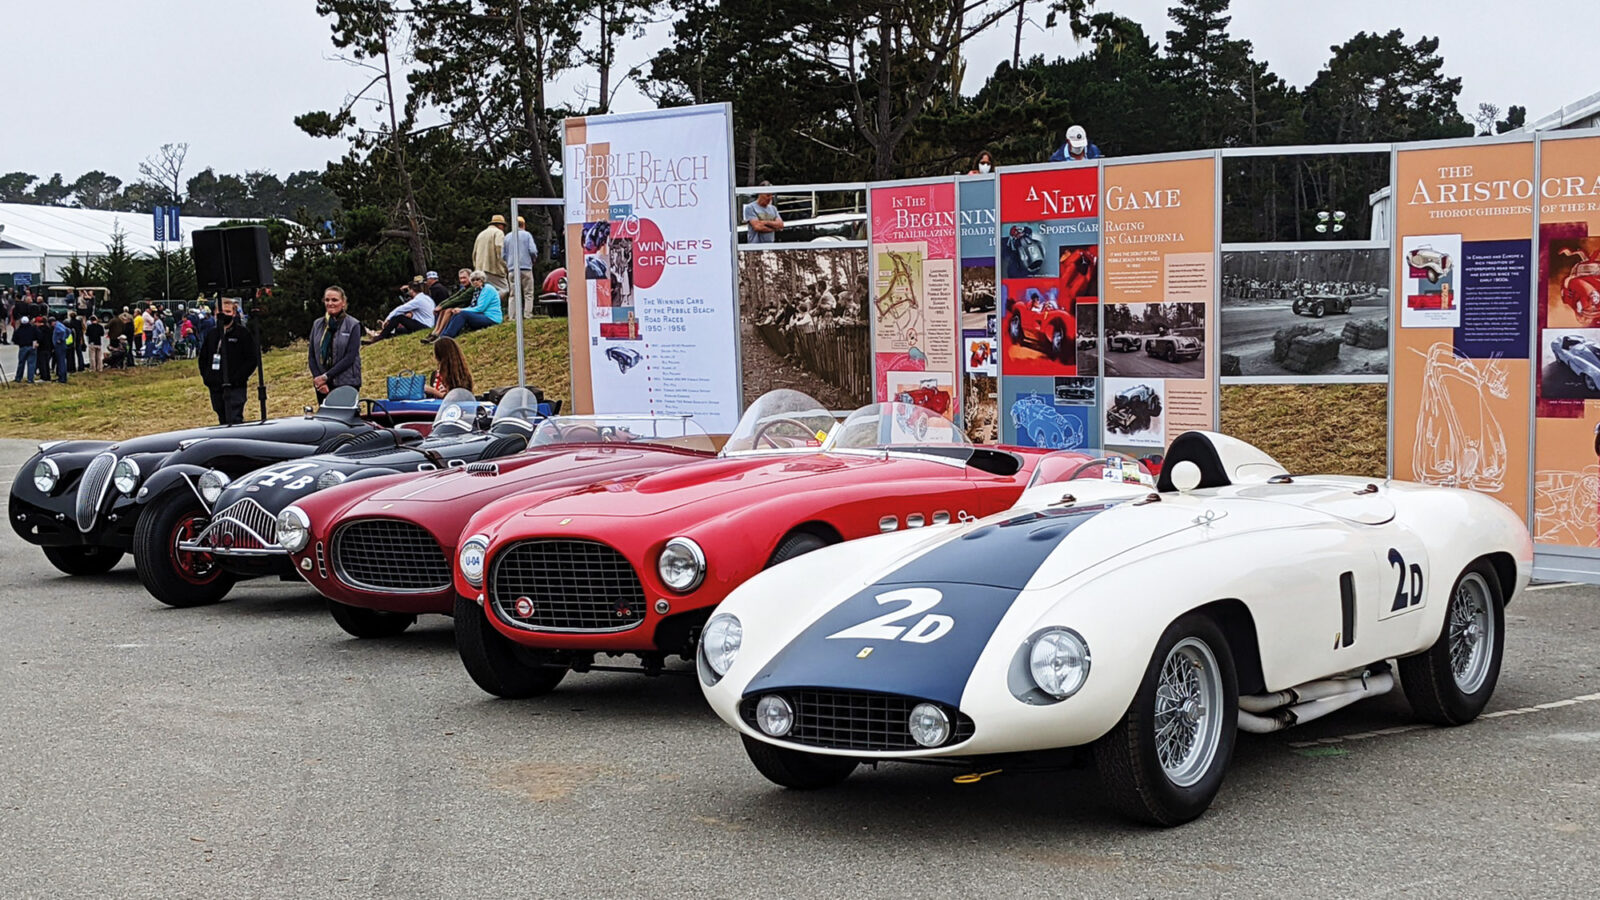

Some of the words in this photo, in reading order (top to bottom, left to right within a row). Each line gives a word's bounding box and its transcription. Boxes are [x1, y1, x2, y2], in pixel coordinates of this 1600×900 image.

[574, 147, 636, 179] PEBBLE
[640, 150, 708, 184] BEACH
[1438, 165, 1473, 179] THE
[580, 171, 635, 204] ROAD
[635, 176, 698, 209] RACES
[892, 196, 903, 208] IN
[905, 195, 926, 207] THE
[1025, 185, 1039, 202] A
[1040, 190, 1097, 215] NEW
[1106, 185, 1181, 212] GAME
[1429, 206, 1532, 219] THOROUGHBREDS
[1541, 205, 1557, 214] OF
[1560, 203, 1586, 212] THE
[893, 229, 956, 240] TRAILBLAZING
[961, 227, 987, 236] ROAD
[1039, 223, 1077, 236] SPORTS
[1077, 221, 1099, 233] CAR
[1105, 220, 1145, 233] RACING
[1105, 234, 1117, 245] IN
[1118, 232, 1185, 245] CALIFORNIA
[638, 239, 712, 252] WINNER'S
[638, 254, 698, 267] CIRCLE
[656, 297, 684, 305] WINNING
[686, 297, 704, 305] CARS
[667, 306, 691, 314] PEBBLE
[693, 306, 715, 314] BEACH
[644, 315, 661, 323] ROAD
[663, 315, 684, 323] RACES
[465, 555, 480, 566] U-04
[1388, 547, 1424, 613] 2D
[825, 587, 955, 644] 2D
